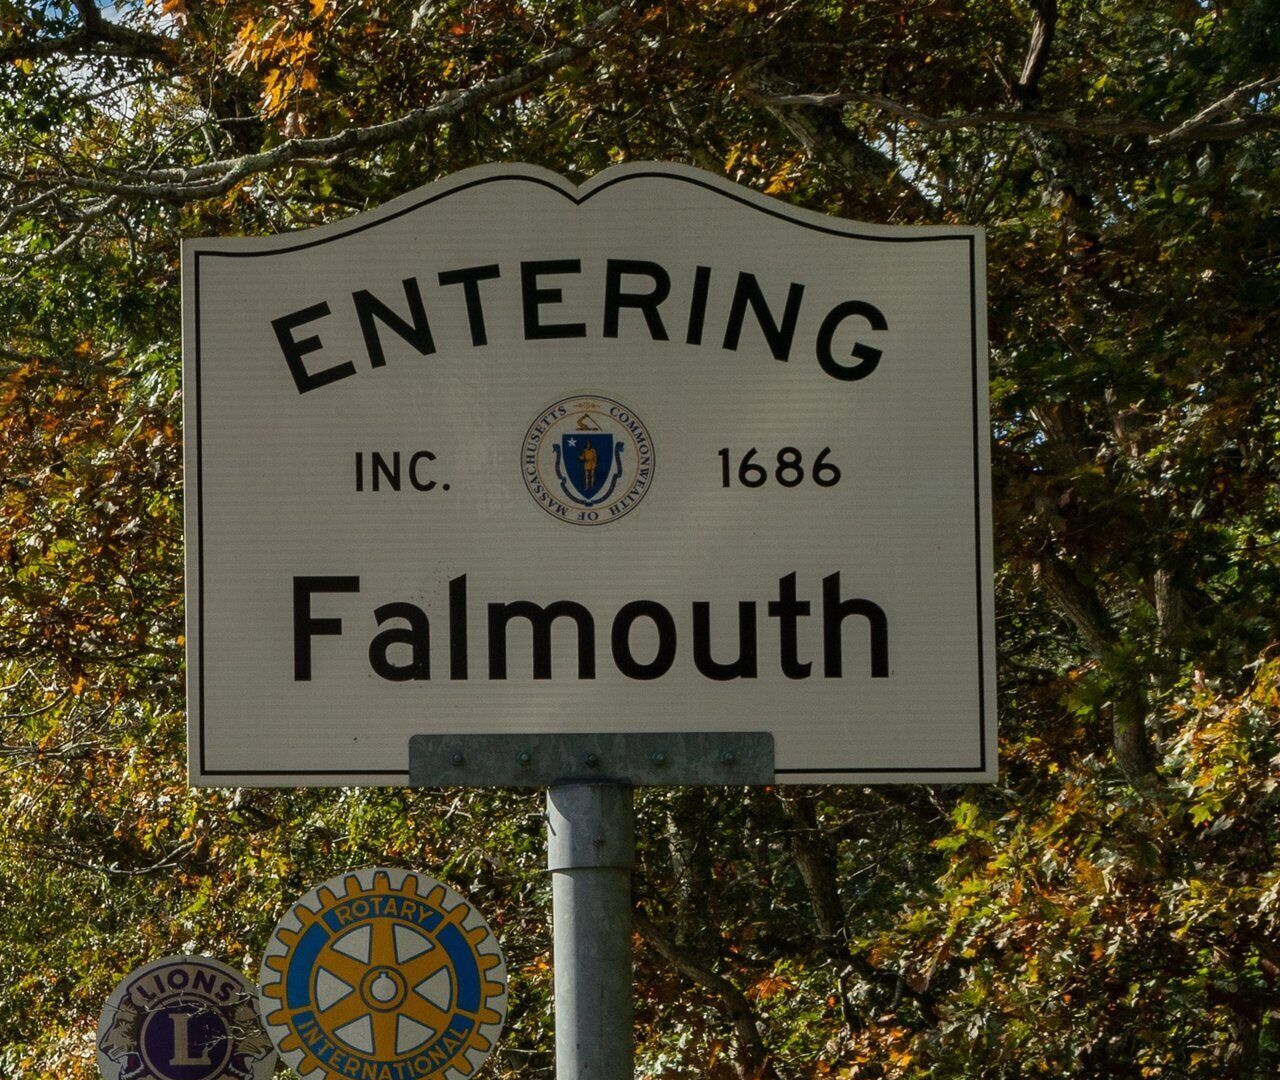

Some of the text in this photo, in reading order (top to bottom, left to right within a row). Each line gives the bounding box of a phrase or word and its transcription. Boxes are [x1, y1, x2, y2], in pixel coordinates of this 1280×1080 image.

[270, 258, 890, 395] ENTERING
[355, 449, 451, 493] INC.
[526, 405, 650, 521] COMMONWEALTH OF MASSACHUSETTS
[718, 446, 842, 489] 1686
[292, 570, 890, 682] Falmouth
[334, 896, 434, 926] ROTARY
[136, 968, 236, 1004] LIONS
[168, 1013, 212, 1066] L
